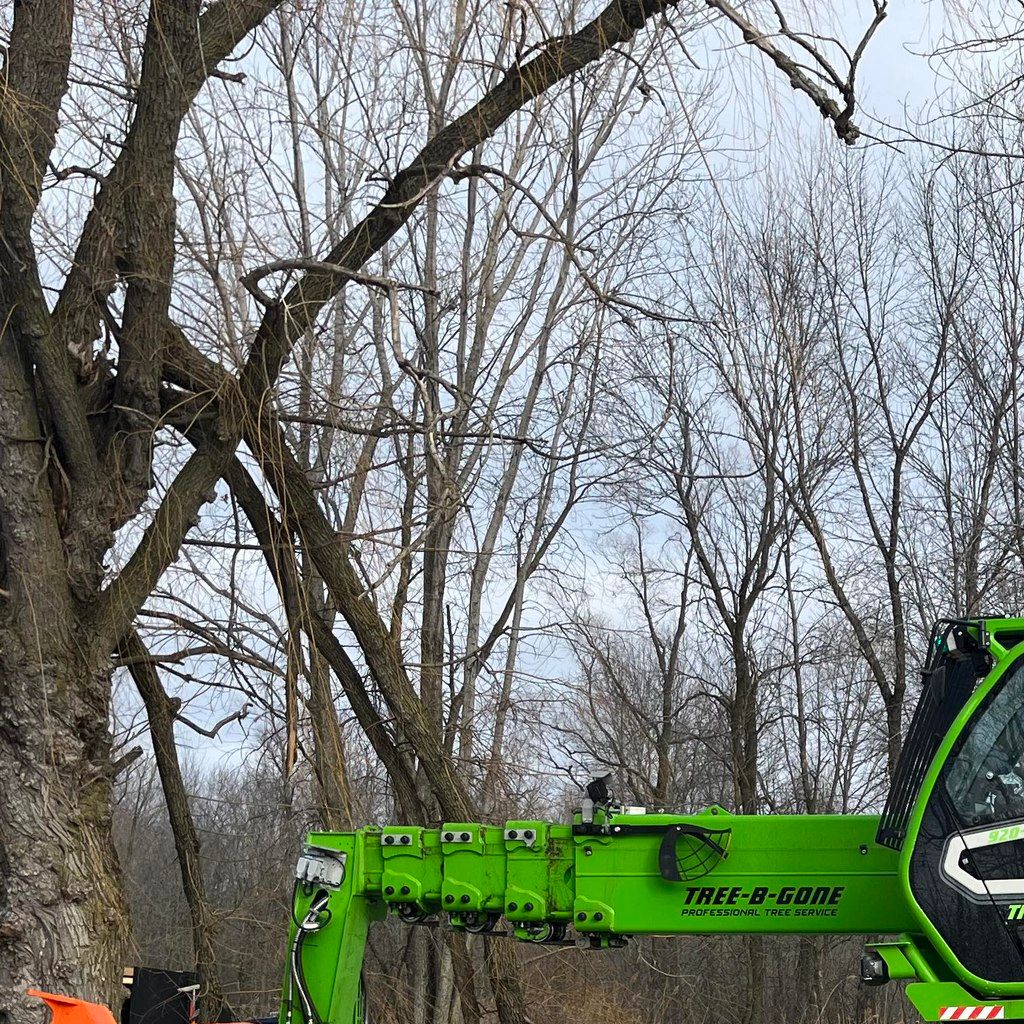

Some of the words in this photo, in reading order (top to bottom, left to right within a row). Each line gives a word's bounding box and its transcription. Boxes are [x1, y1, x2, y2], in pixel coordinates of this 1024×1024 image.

[684, 887, 845, 905] TREE-B-GONE
[681, 908, 761, 917] PROFESSIONAL
[765, 908, 792, 917] TREE
[794, 908, 838, 917] SERVICE
